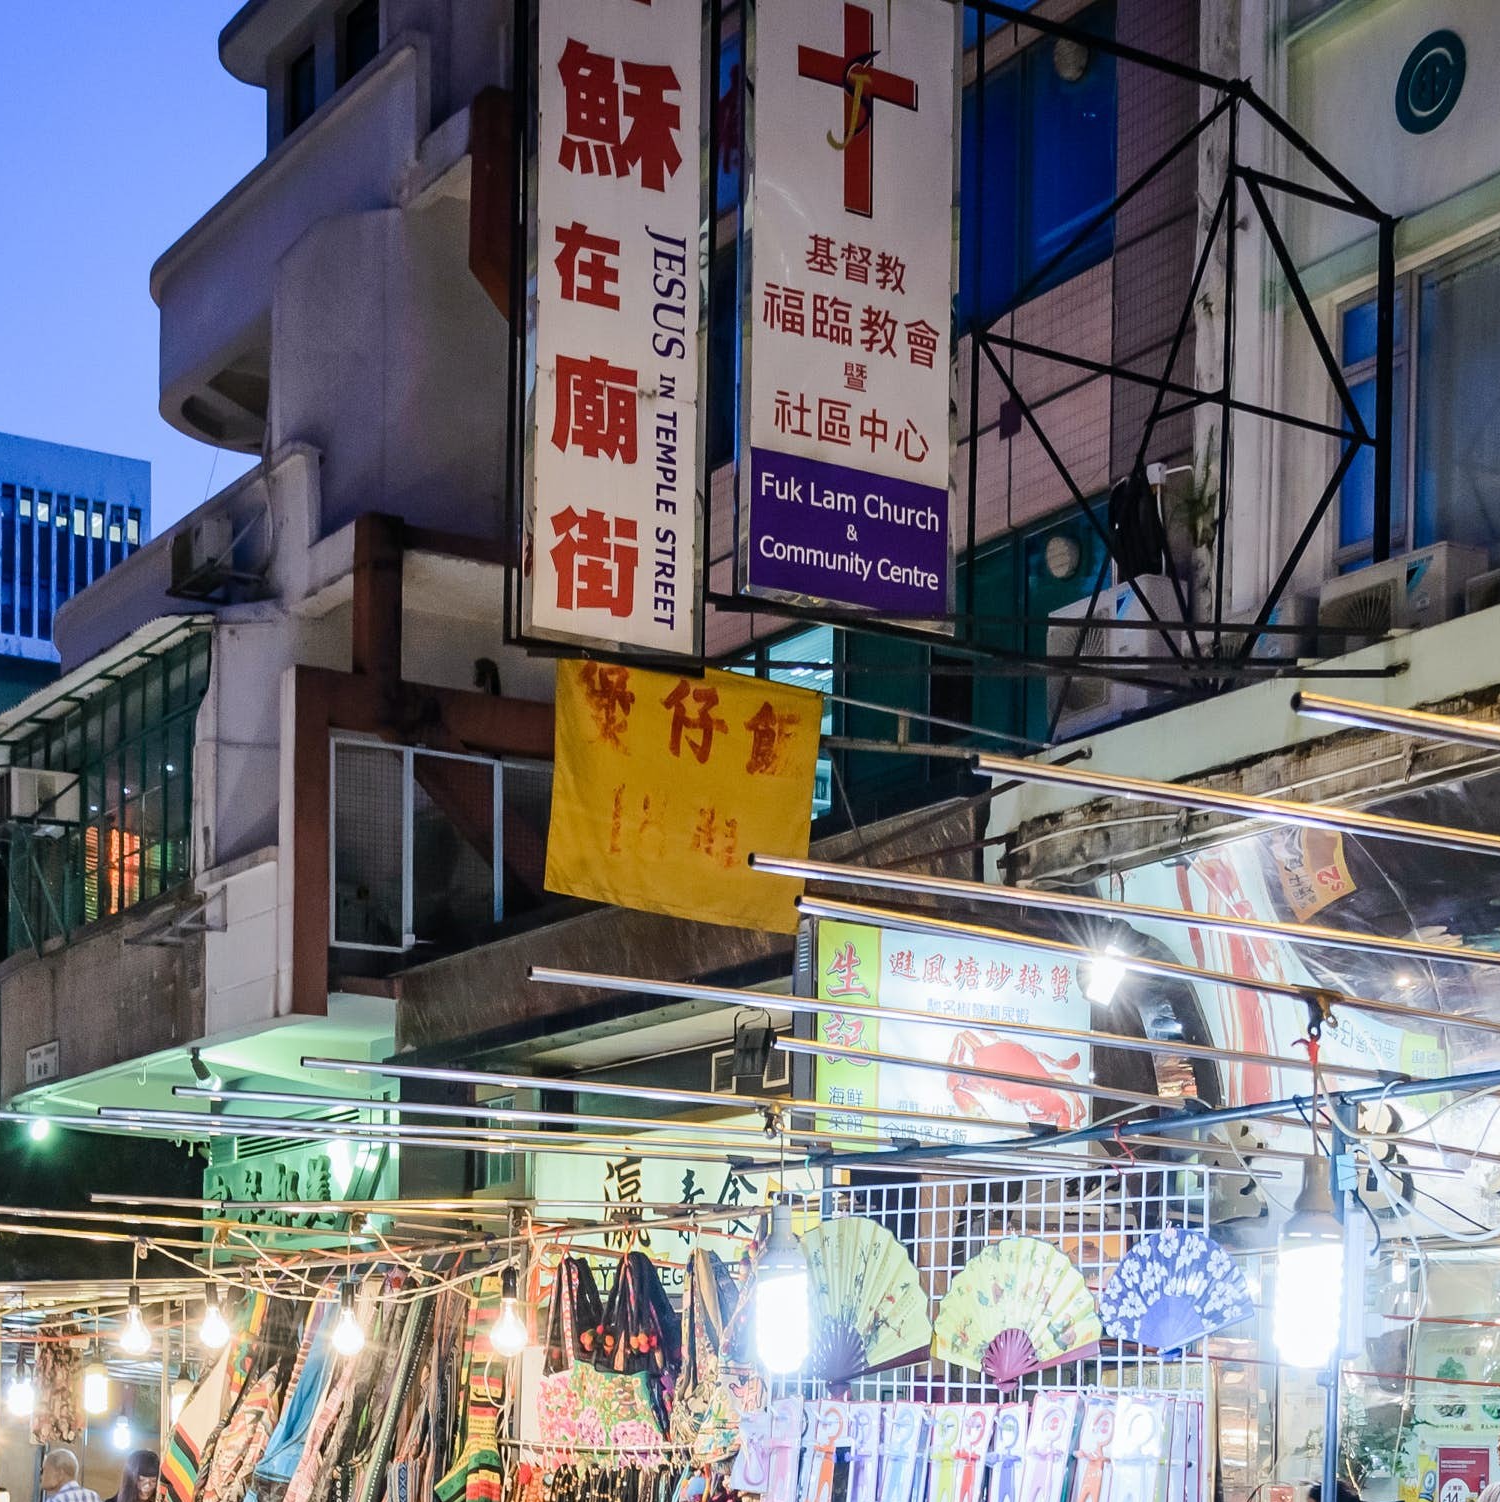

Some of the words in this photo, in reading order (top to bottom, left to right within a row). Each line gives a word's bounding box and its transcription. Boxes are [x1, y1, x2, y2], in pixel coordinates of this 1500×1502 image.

[644, 224, 687, 360] JESUS
[805, 233, 906, 295] 基督教
[550, 0, 683, 616] 穌在廟街
[763, 282, 941, 370] 福臨教會
[656, 373, 675, 399] IN
[844, 361, 868, 392] 暨
[774, 390, 930, 463] 社區中心
[655, 411, 678, 516] TEMPLE
[761, 472, 803, 504] Fuk
[810, 482, 856, 516] Lam
[864, 494, 939, 532] Church
[846, 523, 858, 541] &
[653, 526, 676, 631] STREET
[760, 535, 873, 582] Community
[877, 558, 939, 591] Centre
